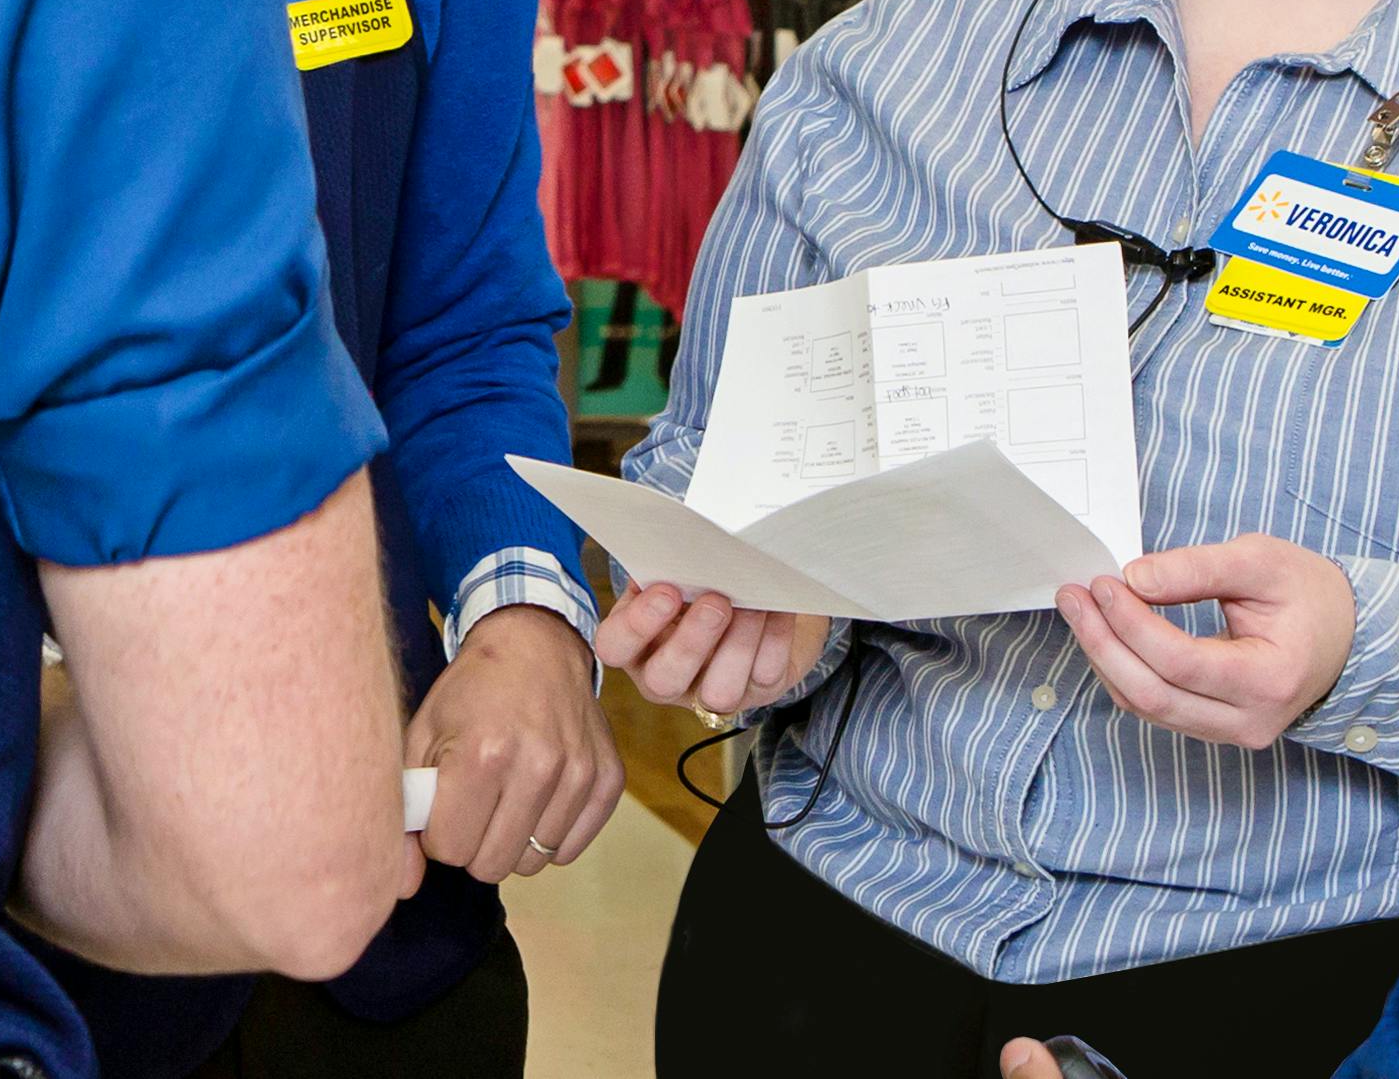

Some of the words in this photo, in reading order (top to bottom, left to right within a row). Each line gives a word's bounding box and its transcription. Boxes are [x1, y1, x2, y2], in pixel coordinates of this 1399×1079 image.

[299, 15, 392, 46] SUPERVISOR
[1285, 203, 1399, 258] VERONICA
[1247, 242, 1270, 255] Save
[1300, 258, 1321, 272] Live
[1217, 284, 1307, 311] ASSISTANT
[1308, 302, 1349, 321] MGR.
